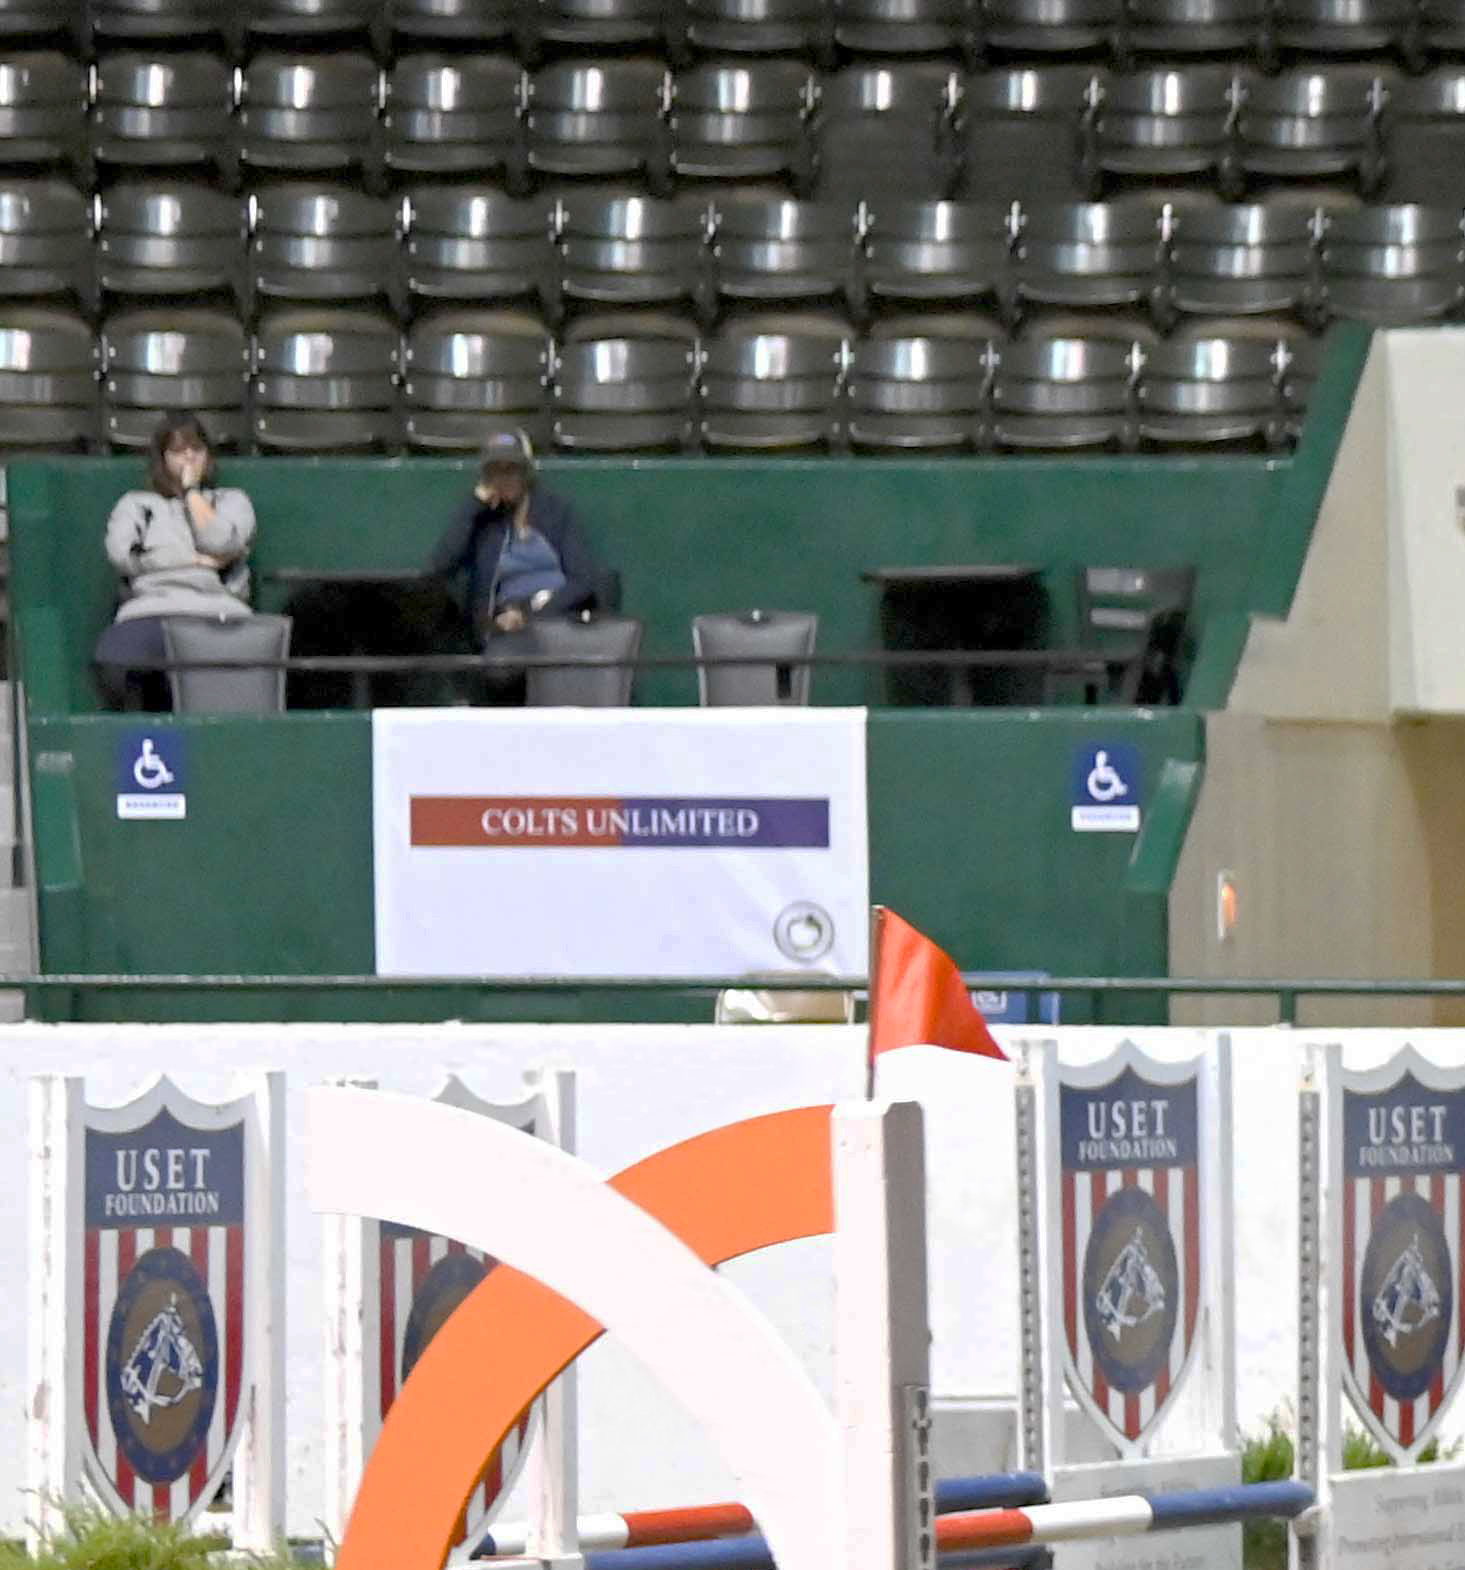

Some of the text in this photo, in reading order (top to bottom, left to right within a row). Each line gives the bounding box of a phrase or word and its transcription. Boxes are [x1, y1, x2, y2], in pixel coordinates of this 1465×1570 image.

[481, 808, 759, 837] COLTS UNLIMITED
[1088, 1100, 1169, 1139] USET
[1368, 1105, 1447, 1146] USET
[1079, 1135, 1177, 1161] FOUNDATION
[1359, 1141, 1454, 1167] FOUNDATION
[116, 1148, 211, 1191] USET
[105, 1191, 219, 1216] FOUNDATION
